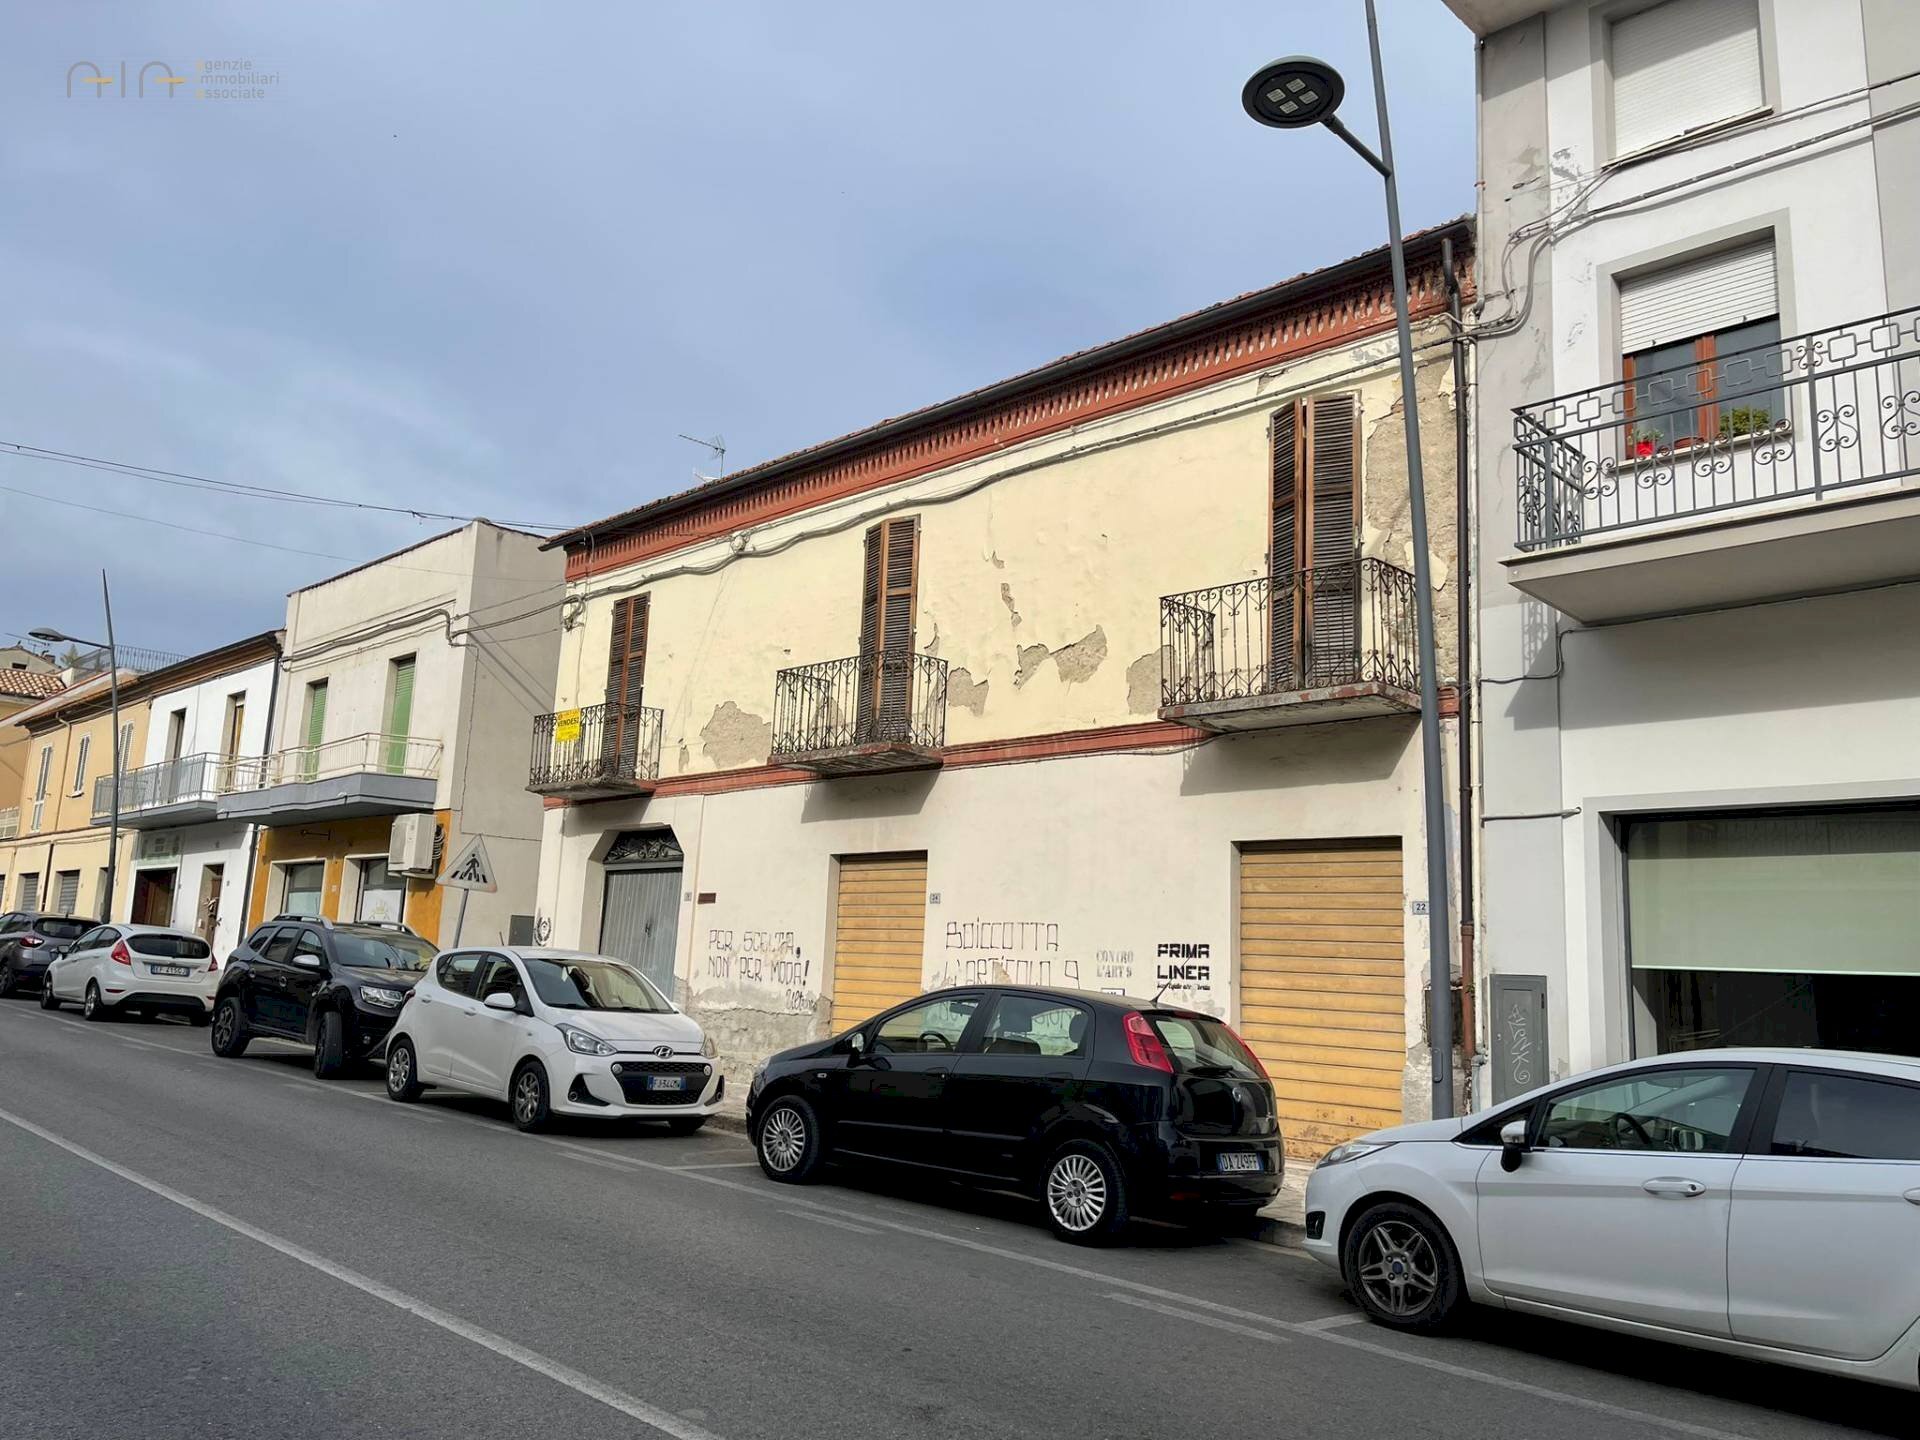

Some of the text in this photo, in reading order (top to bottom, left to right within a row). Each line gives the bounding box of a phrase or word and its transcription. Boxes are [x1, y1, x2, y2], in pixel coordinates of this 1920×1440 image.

[1415, 902, 1426, 911] 22
[708, 929, 733, 952] PER
[1157, 943, 1211, 959] PRIMA
[707, 956, 730, 978] NON
[739, 957, 763, 982] PER
[1157, 964, 1211, 981] LINEA
